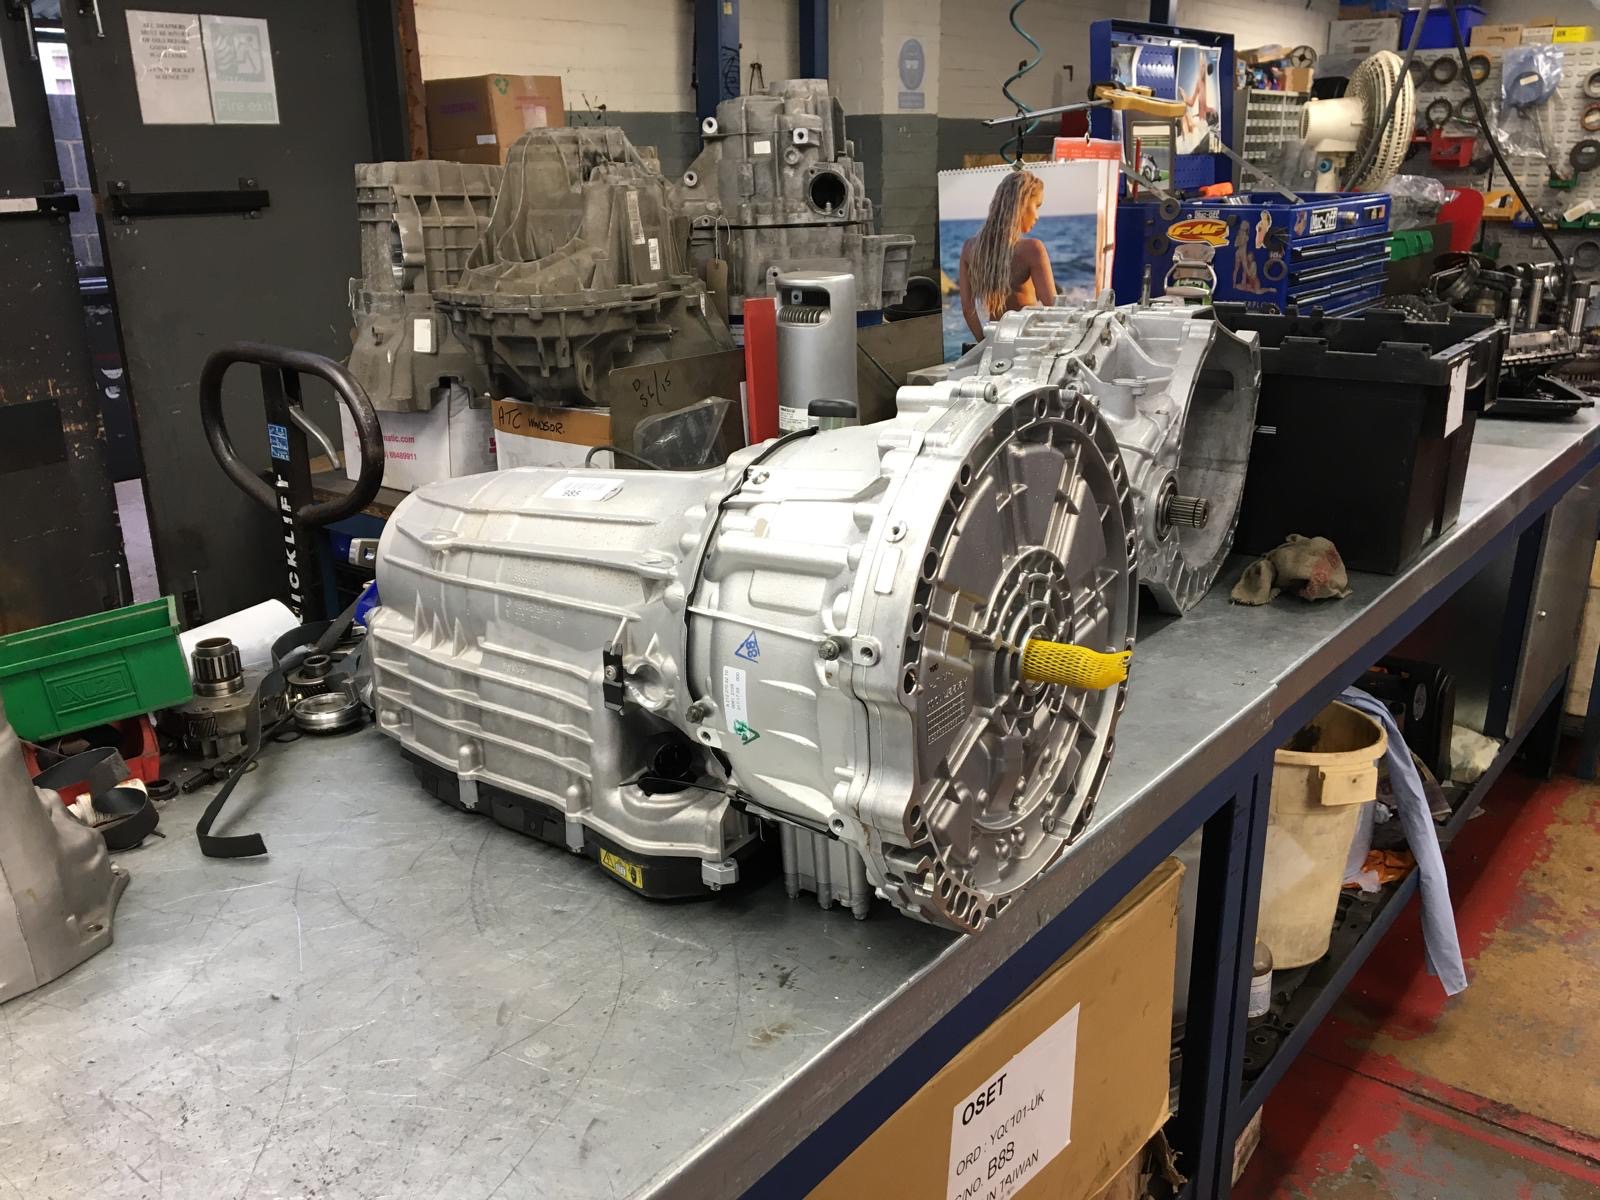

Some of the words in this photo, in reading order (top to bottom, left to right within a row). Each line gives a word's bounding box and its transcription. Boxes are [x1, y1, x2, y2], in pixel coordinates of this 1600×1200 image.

[219, 98, 244, 112] Fire
[247, 98, 273, 112] exit
[1171, 223, 1227, 236] FMF
[498, 406, 522, 429] ATC
[962, 1072, 1007, 1126] OSET
[999, 1149, 1039, 1192] TAIWAN
